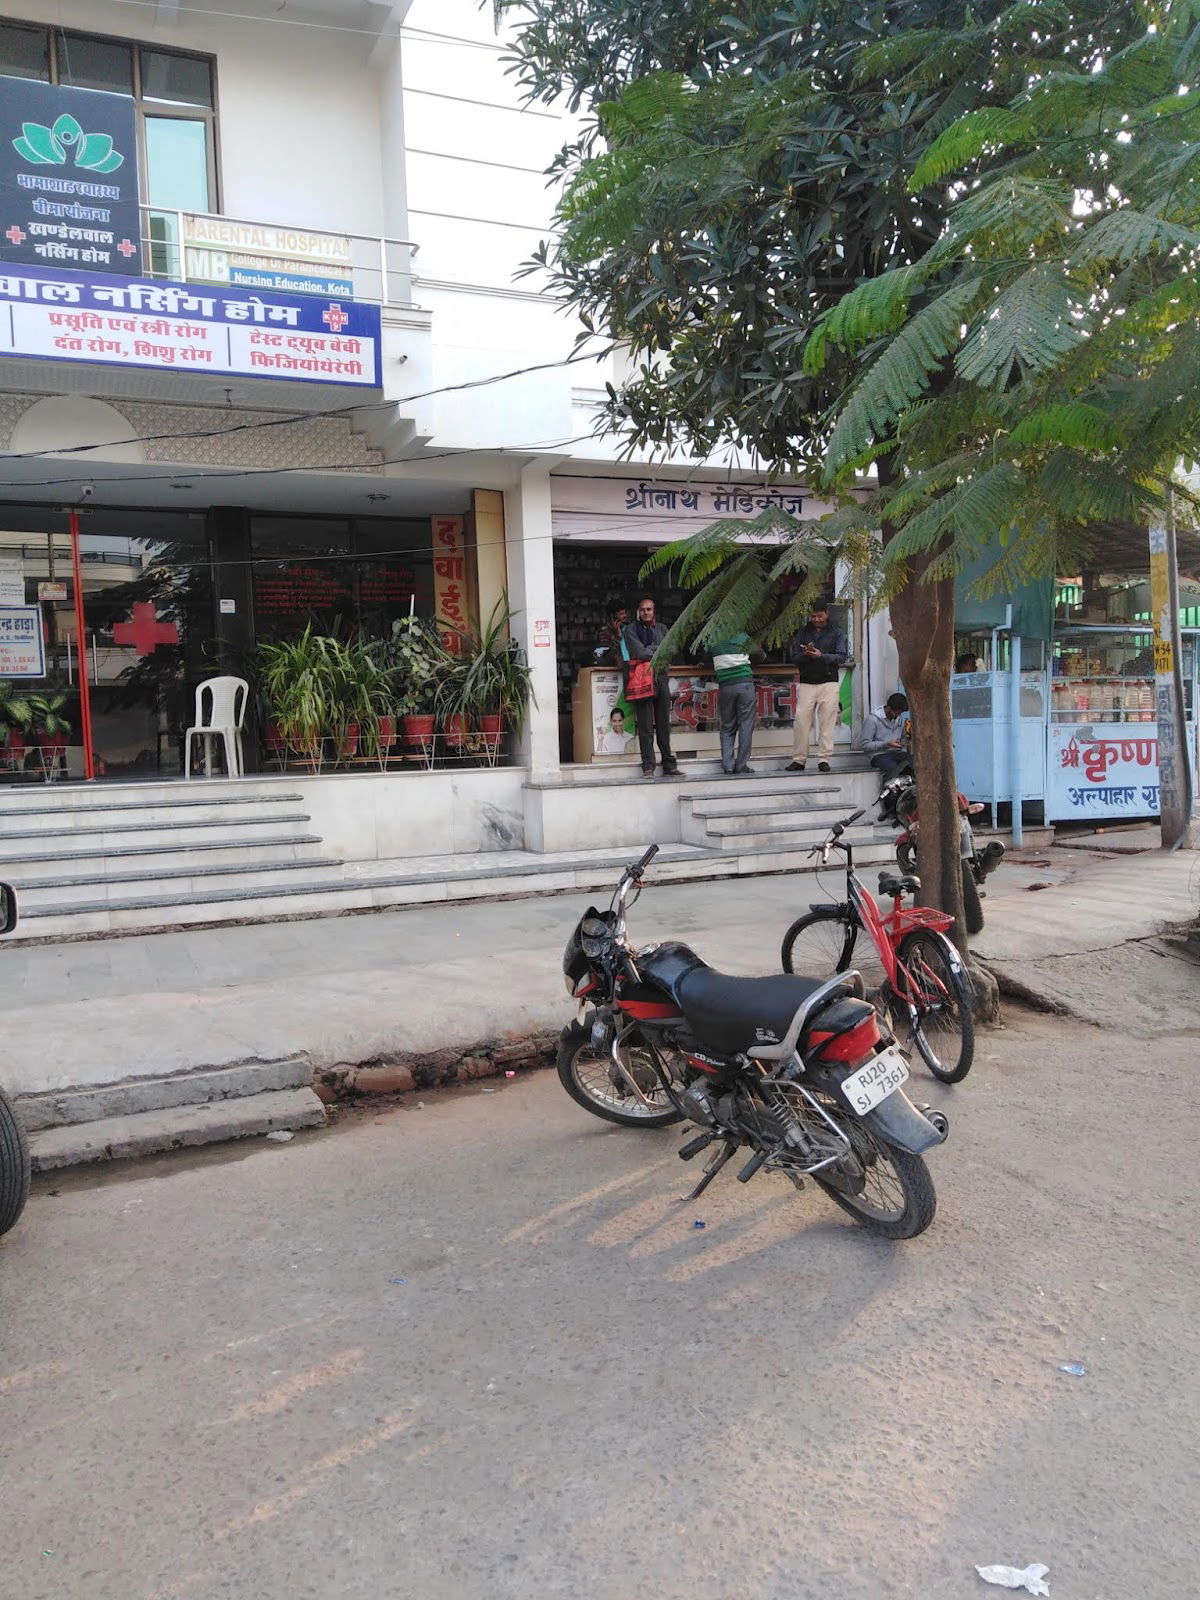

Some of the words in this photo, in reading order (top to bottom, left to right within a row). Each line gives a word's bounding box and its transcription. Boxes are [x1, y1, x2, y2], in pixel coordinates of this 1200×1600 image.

[17, 174, 75, 194] भामाशाह
[32, 197, 64, 217] बीमा
[65, 202, 110, 223] योजना
[28, 222, 114, 244] खण्डेलवाल
[34, 242, 79, 261] नर्सिंग
[81, 247, 111, 264] होम
[327, 283, 350, 295] Kota
[90, 283, 217, 317] नर्सिंग
[222, 296, 302, 326] होम
[48, 312, 103, 332] प्रसूति
[107, 317, 138, 332] एवं
[140, 319, 172, 336] स्त्री
[174, 322, 207, 339] रोग
[53, 333, 83, 350] दंत
[86, 336, 129, 357] रोग,
[134, 340, 177, 363] शिशु
[179, 344, 213, 362] रोग
[250, 328, 282, 346] टेस्ट
[287, 336, 326, 354] ट्यूब
[329, 337, 362, 354] बेबी
[250, 351, 363, 376] फिजियोथेरेपी
[625, 483, 701, 512] श्रीनाथ
[1068, 786, 1137, 808] अल्पाहार
[1142, 785, 1161, 810] गृ
[857, 1093, 871, 1110] SJ
[876, 1066, 906, 1094] 7361
[858, 1061, 887, 1089] RJ20
